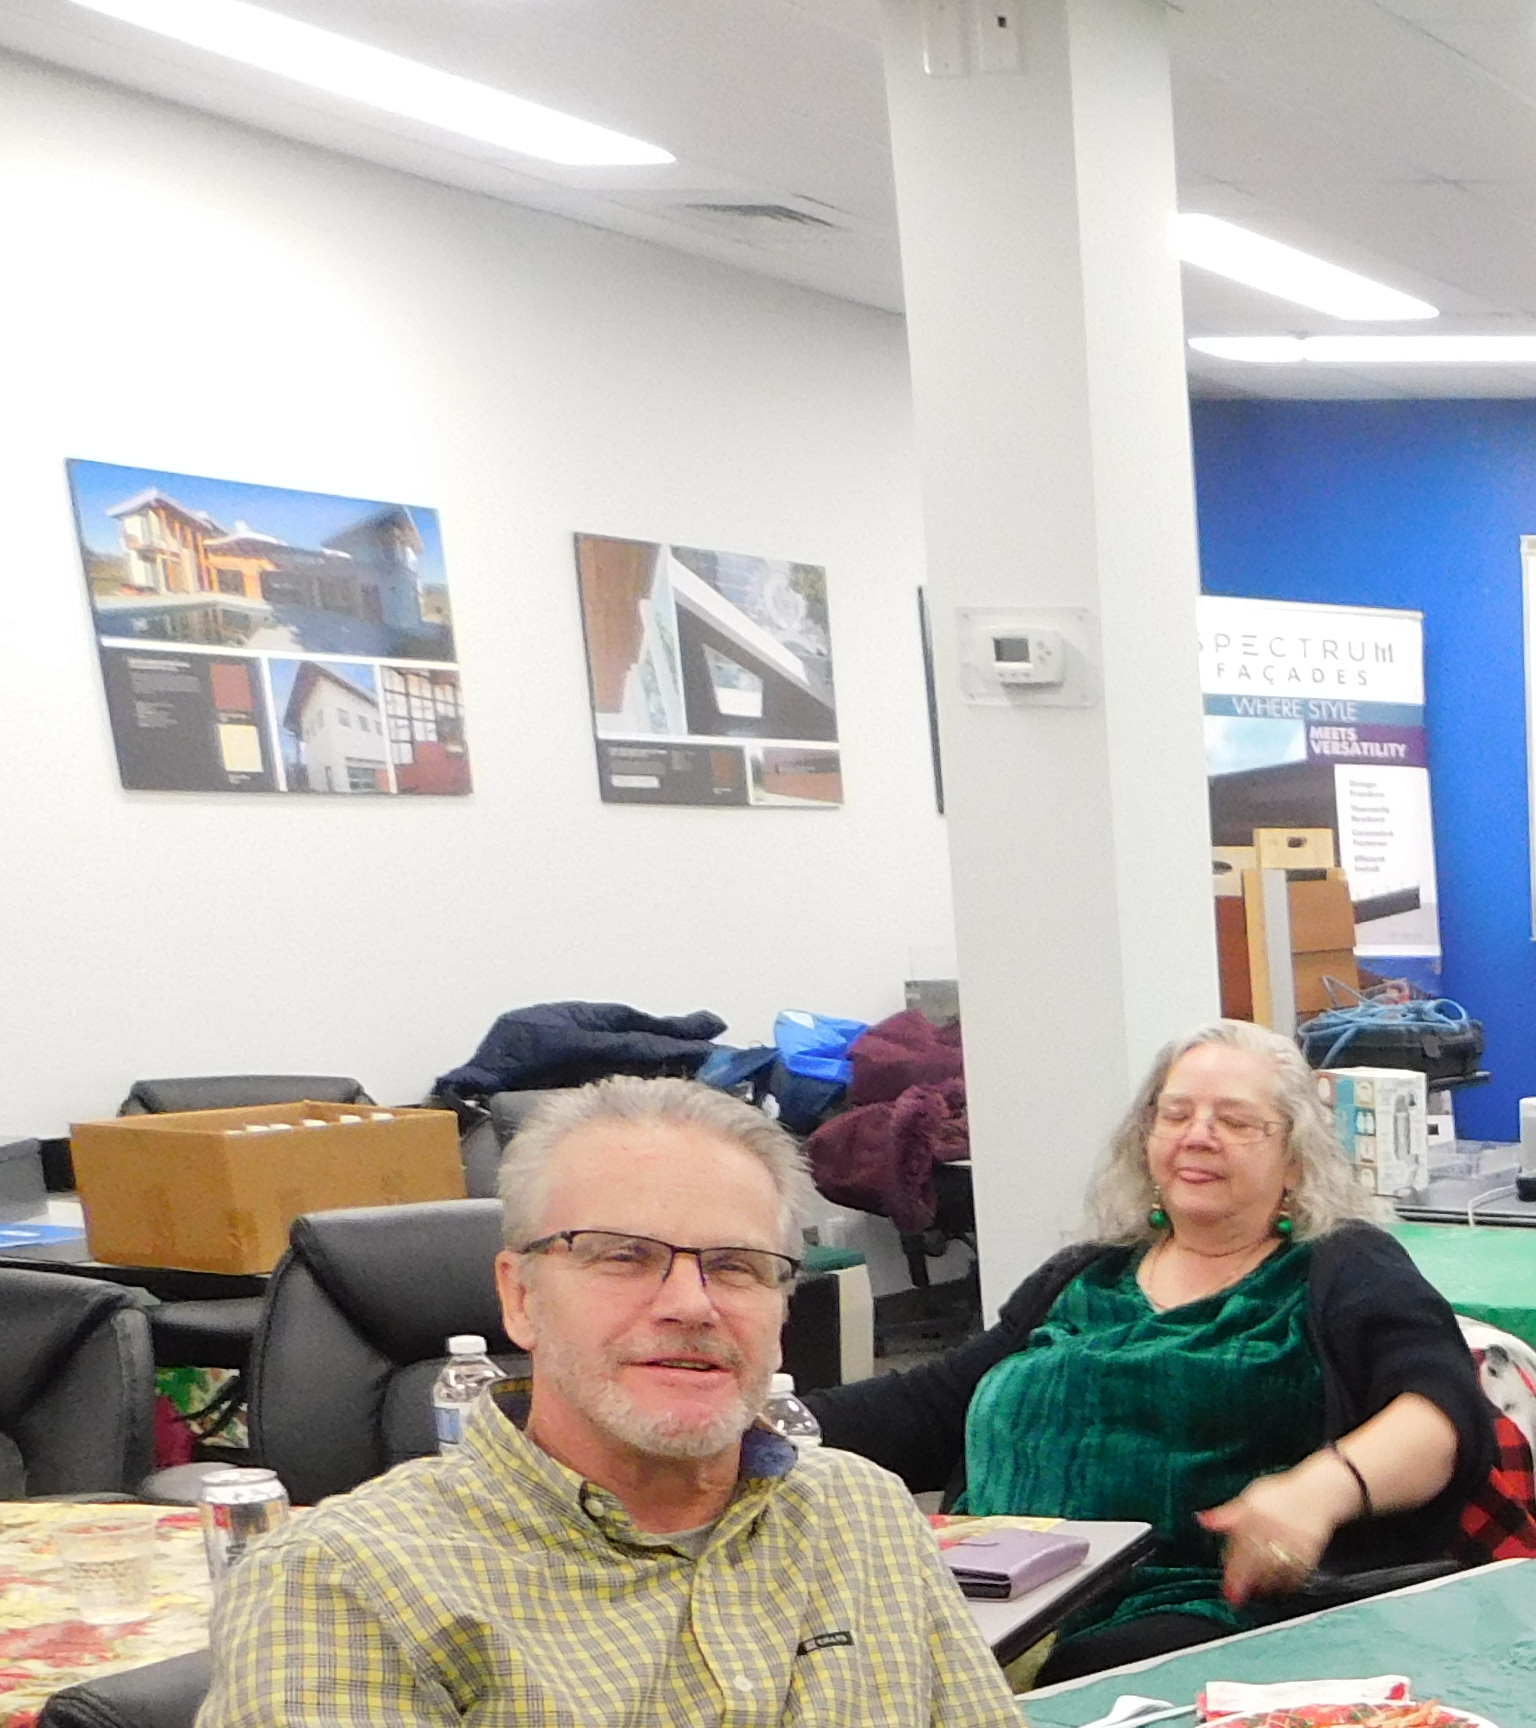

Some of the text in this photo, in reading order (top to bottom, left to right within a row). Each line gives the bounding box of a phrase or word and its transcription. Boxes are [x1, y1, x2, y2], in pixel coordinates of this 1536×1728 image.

[1216, 662, 1368, 687] FAÇADES
[1231, 695, 1359, 721] WHERE STYLE
[1309, 725, 1358, 742] MEETS
[1309, 739, 1408, 758] VERSATILITY
